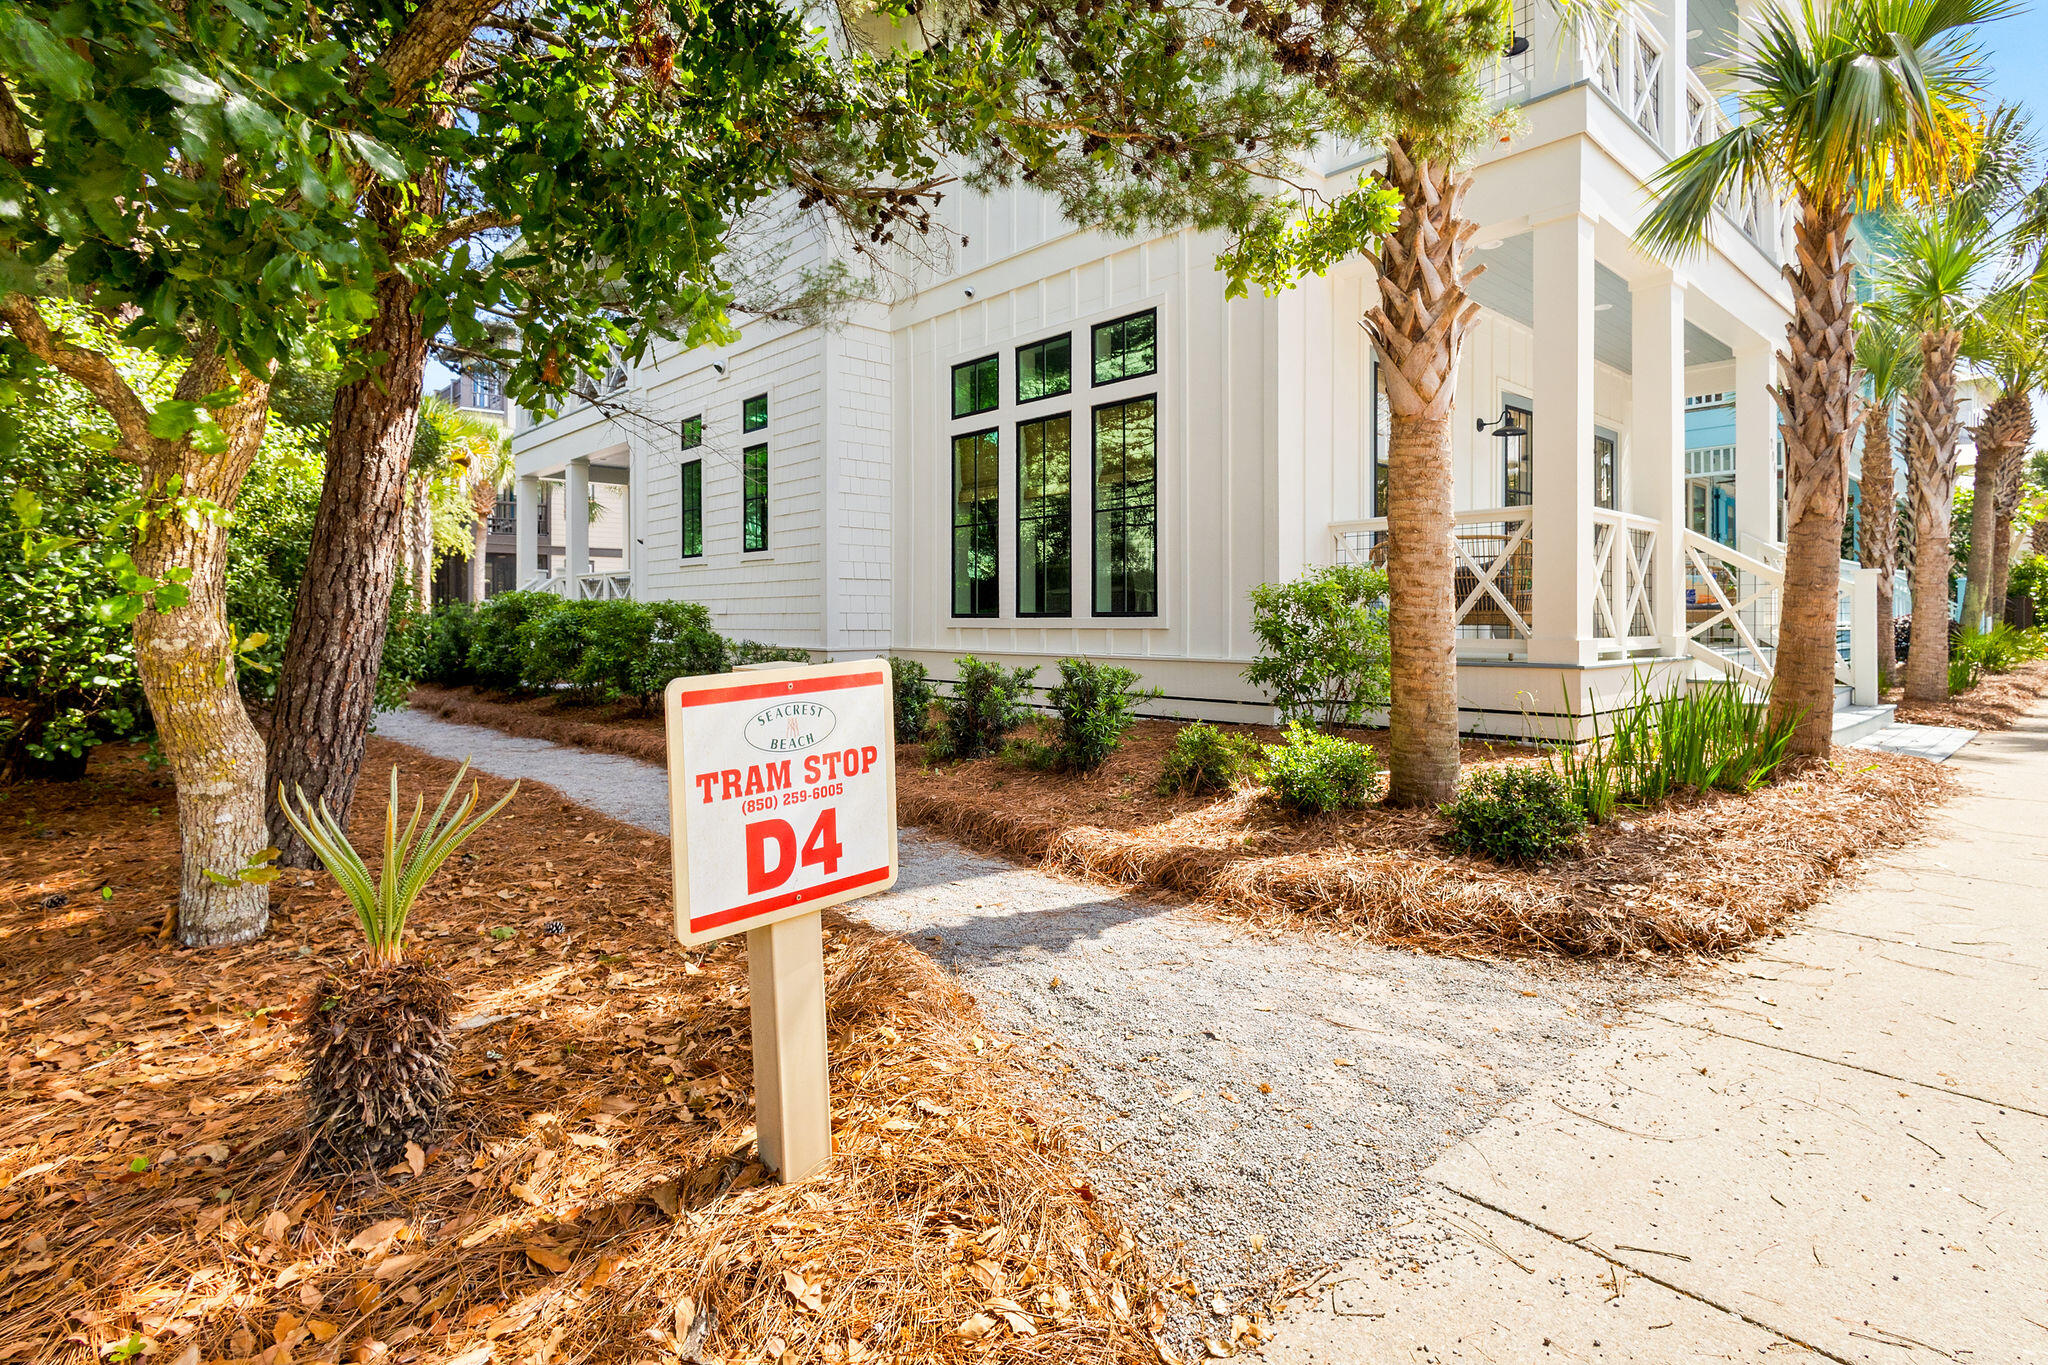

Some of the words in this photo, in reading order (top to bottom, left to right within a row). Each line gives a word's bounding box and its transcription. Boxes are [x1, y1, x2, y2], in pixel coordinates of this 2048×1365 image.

[757, 704, 823, 727] SEACREST
[770, 733, 814, 750] BEACH
[696, 759, 792, 804] TRAM
[804, 746, 877, 785] STOP
[742, 795, 778, 816] (850)
[783, 783, 844, 806] 259-6005
[746, 808, 842, 895] D4
